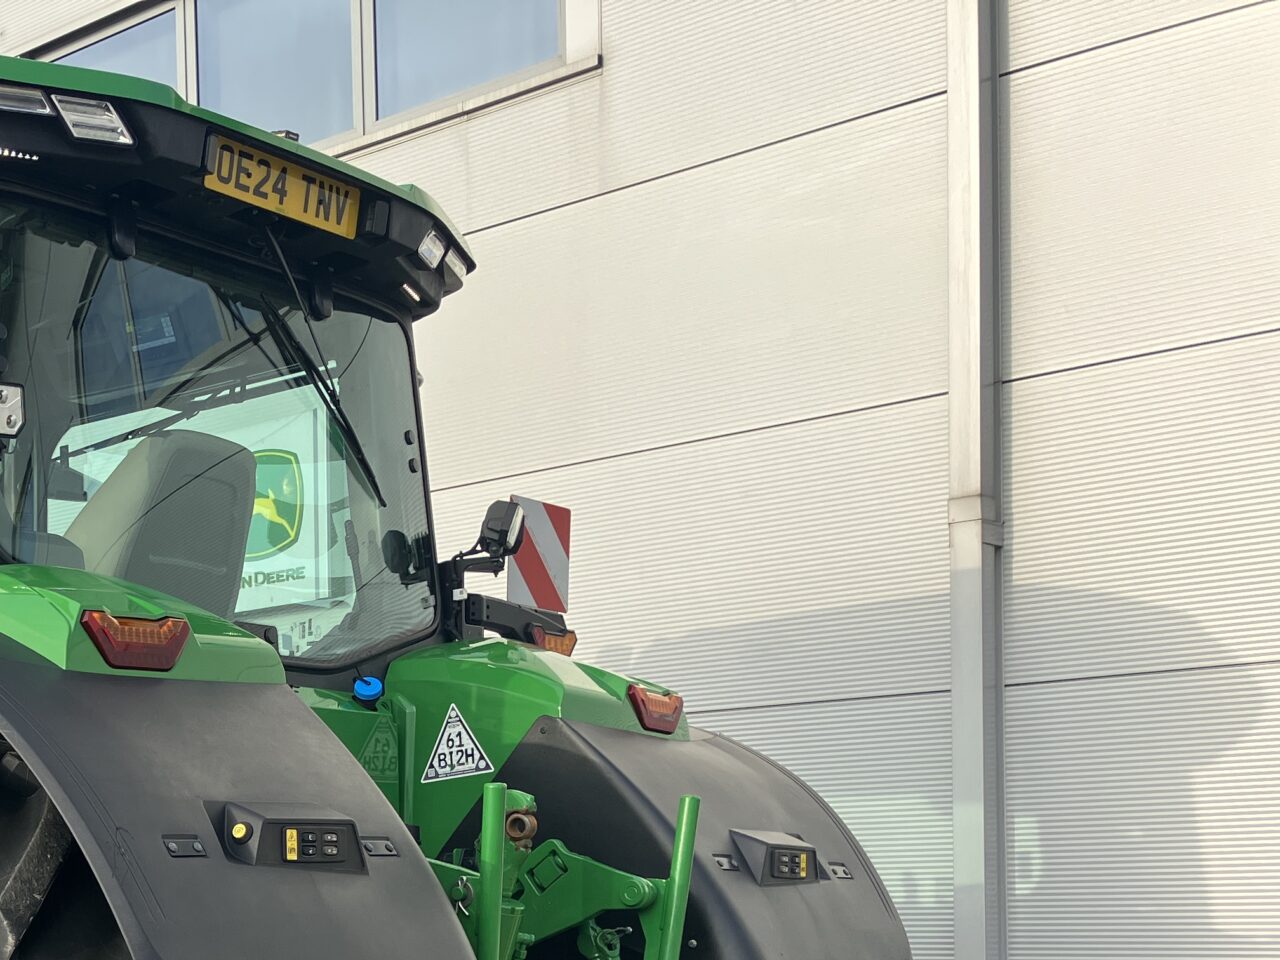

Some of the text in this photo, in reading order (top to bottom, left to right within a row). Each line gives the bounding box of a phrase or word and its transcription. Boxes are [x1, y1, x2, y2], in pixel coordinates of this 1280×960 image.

[216, 144, 349, 225] OE24 TNV
[254, 566, 306, 586] DEERE
[446, 731, 464, 749] 61
